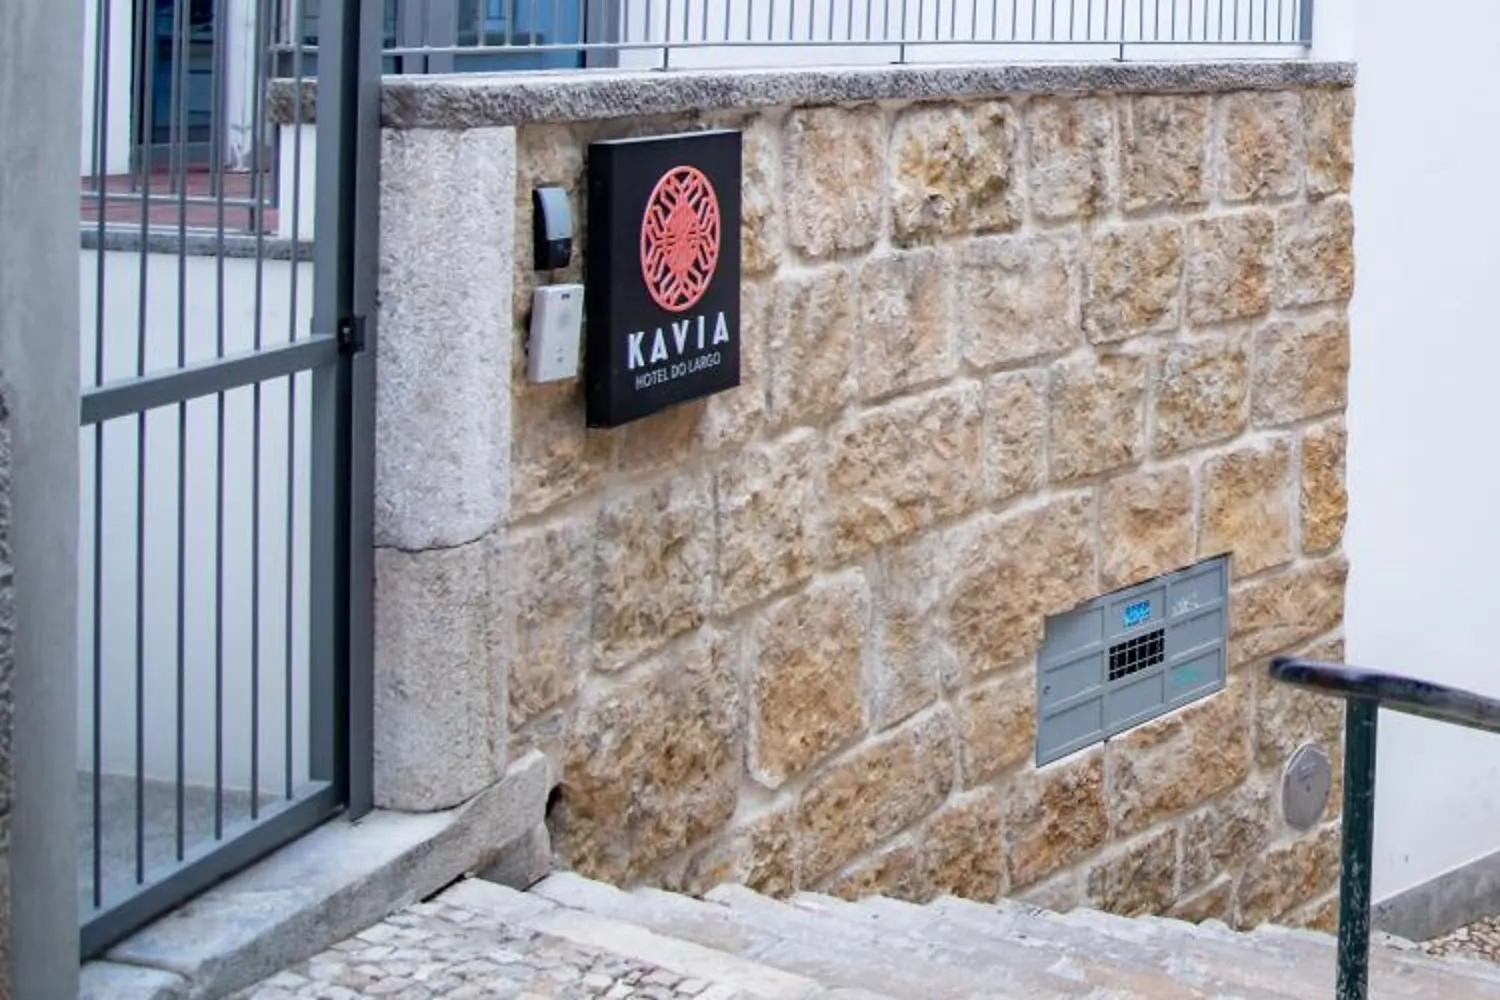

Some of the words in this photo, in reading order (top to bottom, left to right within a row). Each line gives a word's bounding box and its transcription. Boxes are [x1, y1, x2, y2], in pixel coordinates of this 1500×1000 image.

[627, 311, 730, 370] KAVIA
[634, 369, 670, 391] HOTEL
[671, 361, 687, 379] DO
[688, 351, 721, 374] LARGO
